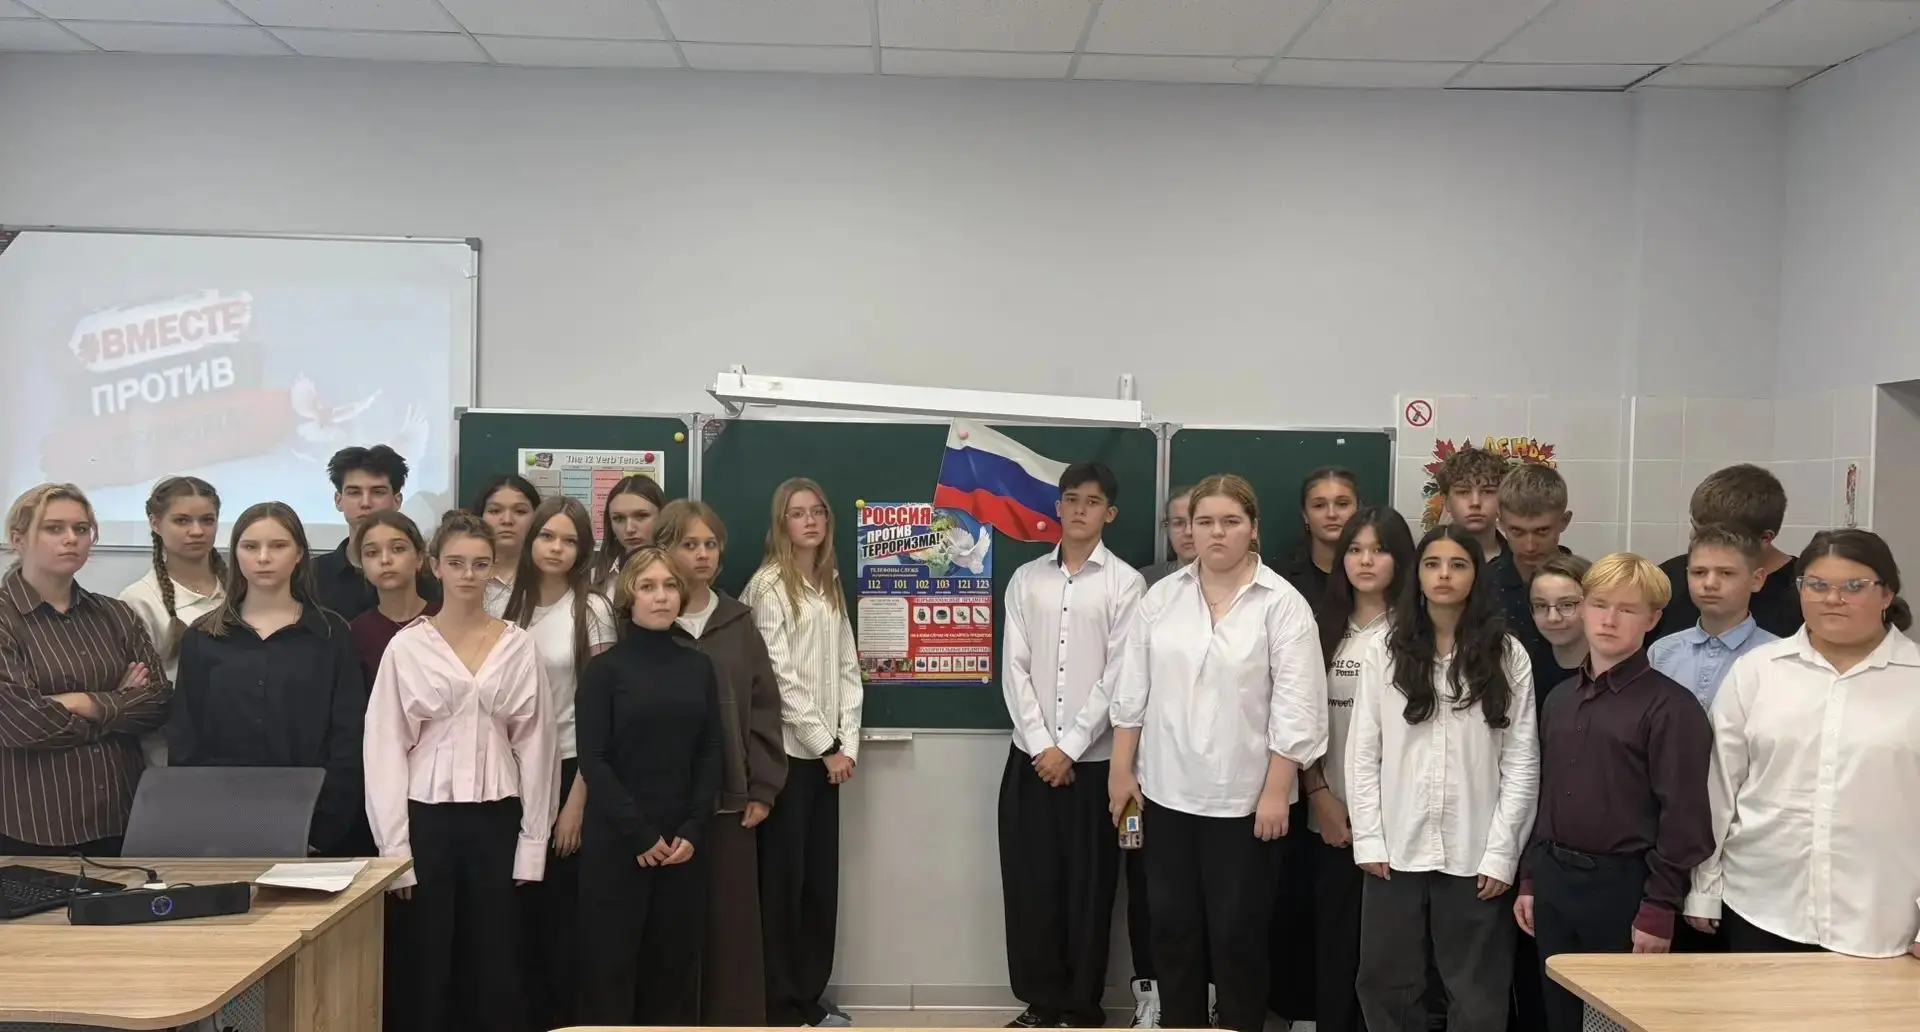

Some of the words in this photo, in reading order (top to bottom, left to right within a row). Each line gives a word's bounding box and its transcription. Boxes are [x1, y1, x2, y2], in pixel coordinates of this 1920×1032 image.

[91, 356, 235, 417] ПРОТИВ
[566, 455, 582, 464] The
[585, 456, 594, 464] 12
[596, 456, 617, 464] Verb
[617, 456, 648, 465] Tense
[863, 507, 932, 525] РОССИЯ
[867, 525, 911, 543] ПРОТИВ
[862, 533, 940, 558] ТЕРРОРИЗМА!
[868, 580, 881, 589] 112
[894, 580, 907, 589] 101
[916, 580, 929, 589] 102
[936, 580, 950, 589] 103
[958, 580, 971, 589] 121
[976, 580, 990, 589] 123
[1330, 660, 1345, 668] elf
[1346, 660, 1361, 668] Co
